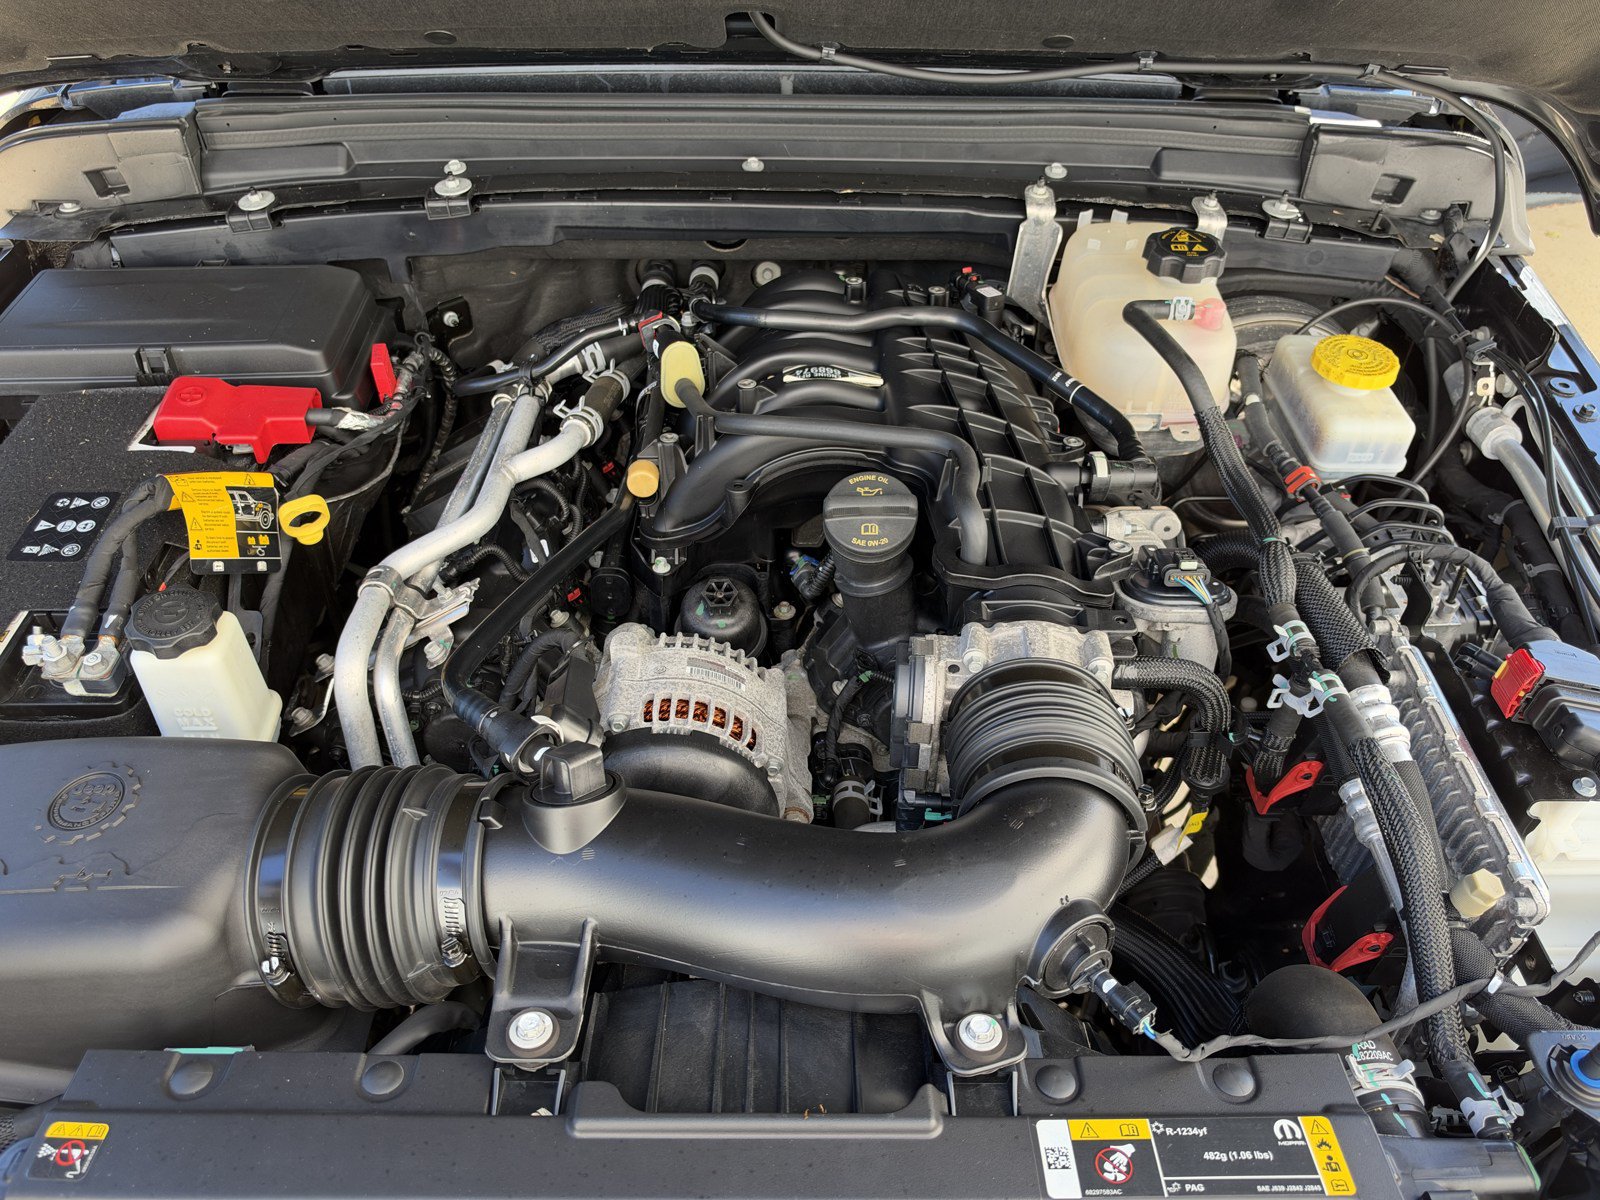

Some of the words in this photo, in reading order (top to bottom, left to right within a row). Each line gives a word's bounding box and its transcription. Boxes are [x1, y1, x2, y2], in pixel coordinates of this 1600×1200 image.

[848, 475, 877, 485] ENGINE
[877, 476, 889, 485] OIL
[851, 537, 866, 547] SAE
[867, 537, 889, 547] 0W-20
[177, 717, 216, 728] MAX
[1357, 1040, 1376, 1050] RAD
[1165, 1127, 1208, 1137] R-1234yf
[1203, 1151, 1228, 1162] 482g
[1229, 1151, 1252, 1161] (1.06
[1254, 1150, 1273, 1161] lbs)
[1184, 1183, 1205, 1192] PAG
